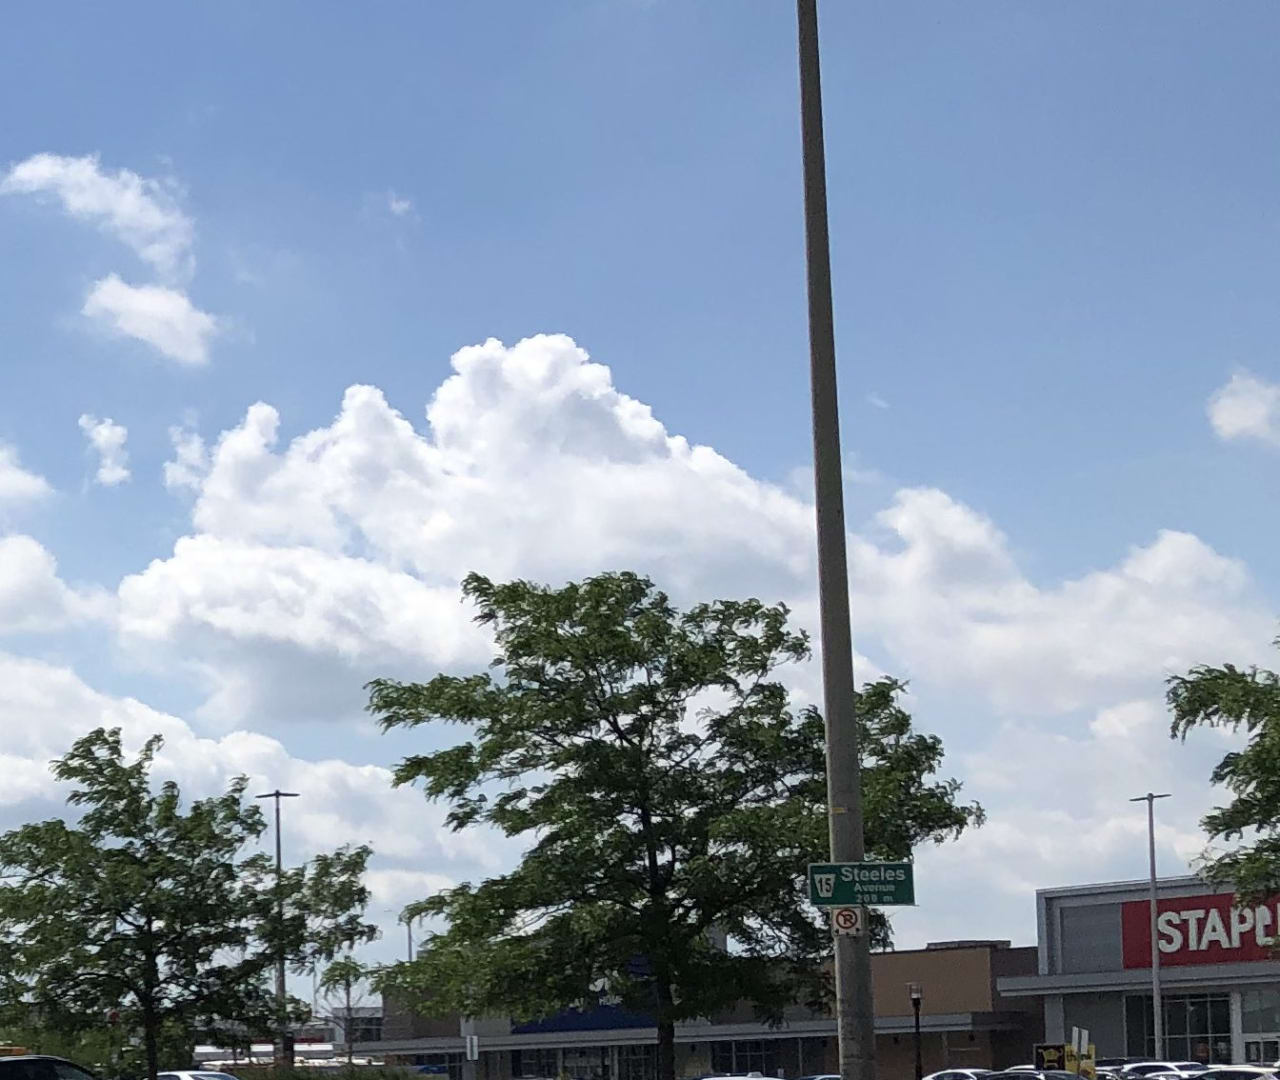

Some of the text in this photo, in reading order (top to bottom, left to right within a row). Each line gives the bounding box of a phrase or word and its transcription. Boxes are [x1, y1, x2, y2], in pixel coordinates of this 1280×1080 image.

[841, 867, 906, 881] Steeles
[817, 878, 832, 893] 15
[854, 883, 895, 892] Avenue
[1157, 903, 1280, 953] STAPL
